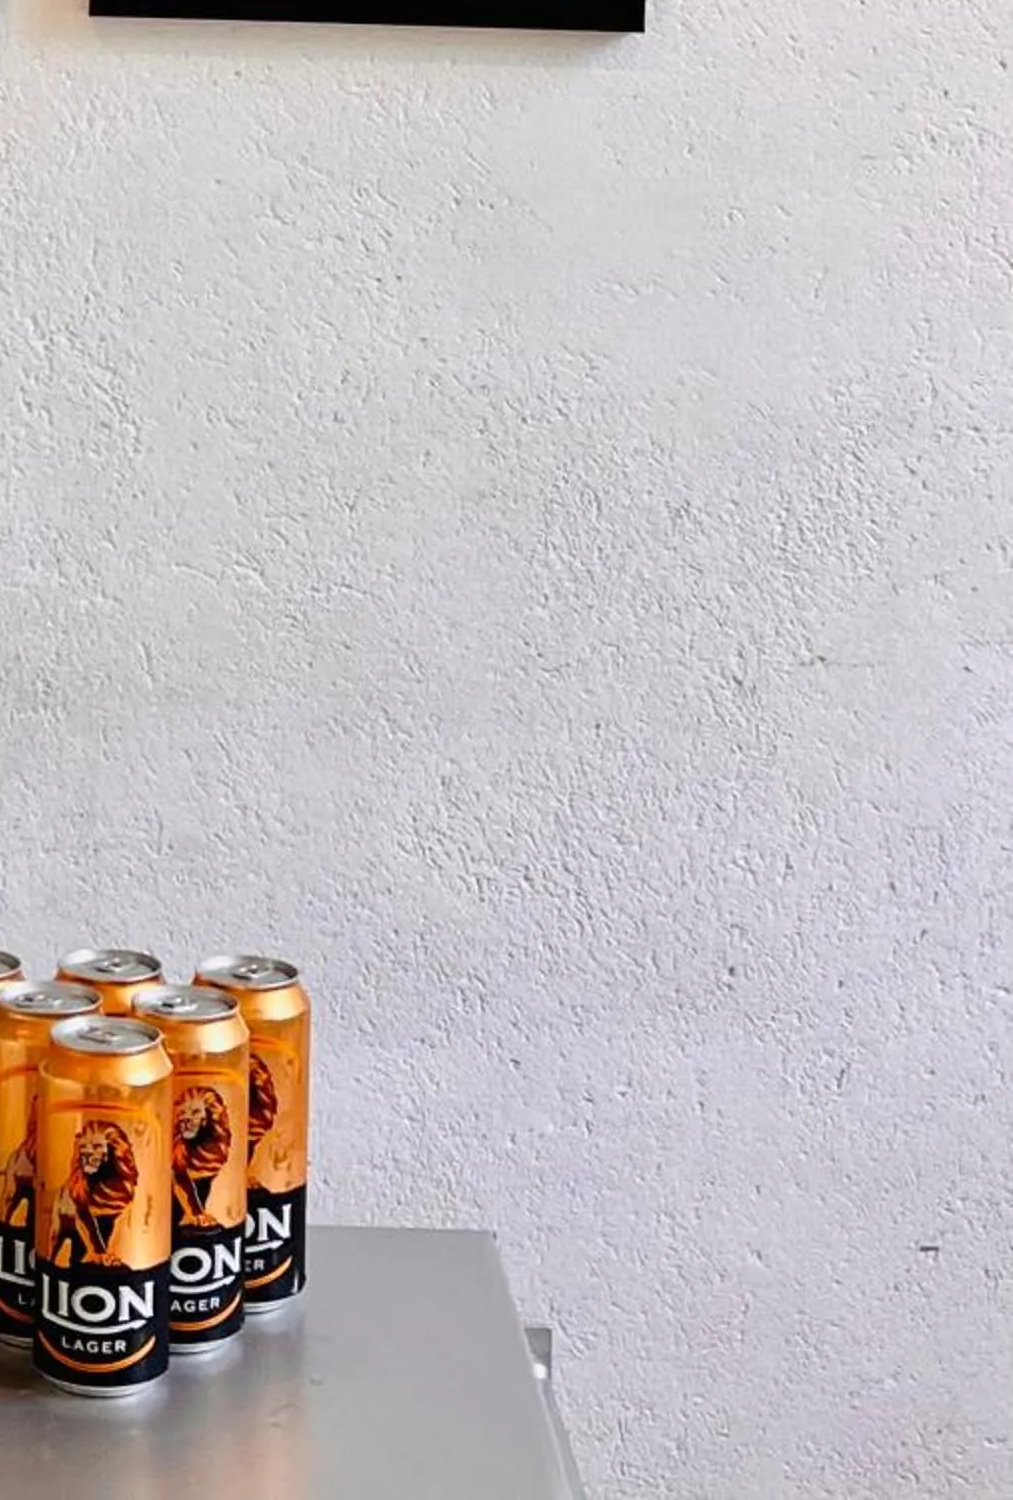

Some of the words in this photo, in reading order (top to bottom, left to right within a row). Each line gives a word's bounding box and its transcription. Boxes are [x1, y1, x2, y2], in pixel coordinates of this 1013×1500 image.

[42, 1272, 155, 1335] LION
[170, 1296, 221, 1313] AGER
[61, 1335, 127, 1355] LAGER
